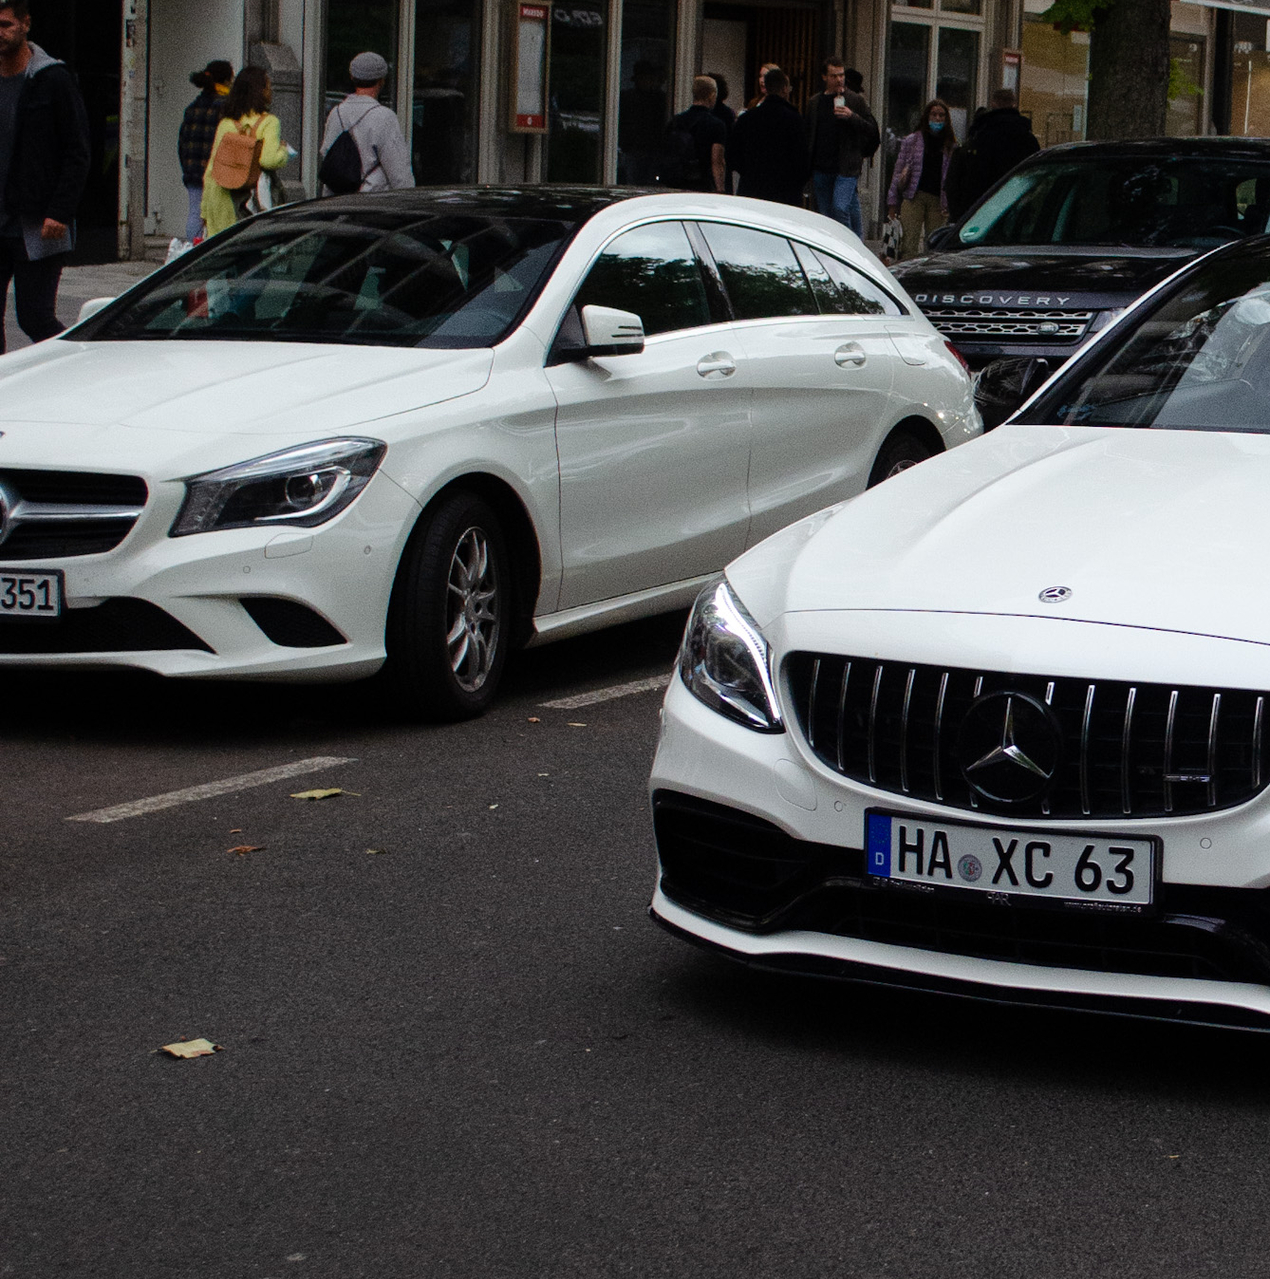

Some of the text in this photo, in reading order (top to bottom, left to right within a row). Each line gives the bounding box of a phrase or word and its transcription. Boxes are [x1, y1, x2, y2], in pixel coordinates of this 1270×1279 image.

[915, 294, 1070, 306] DISCOVERY
[1, 577, 54, 610] 351
[875, 852, 884, 866] D
[899, 826, 1134, 894] HA XC 63
